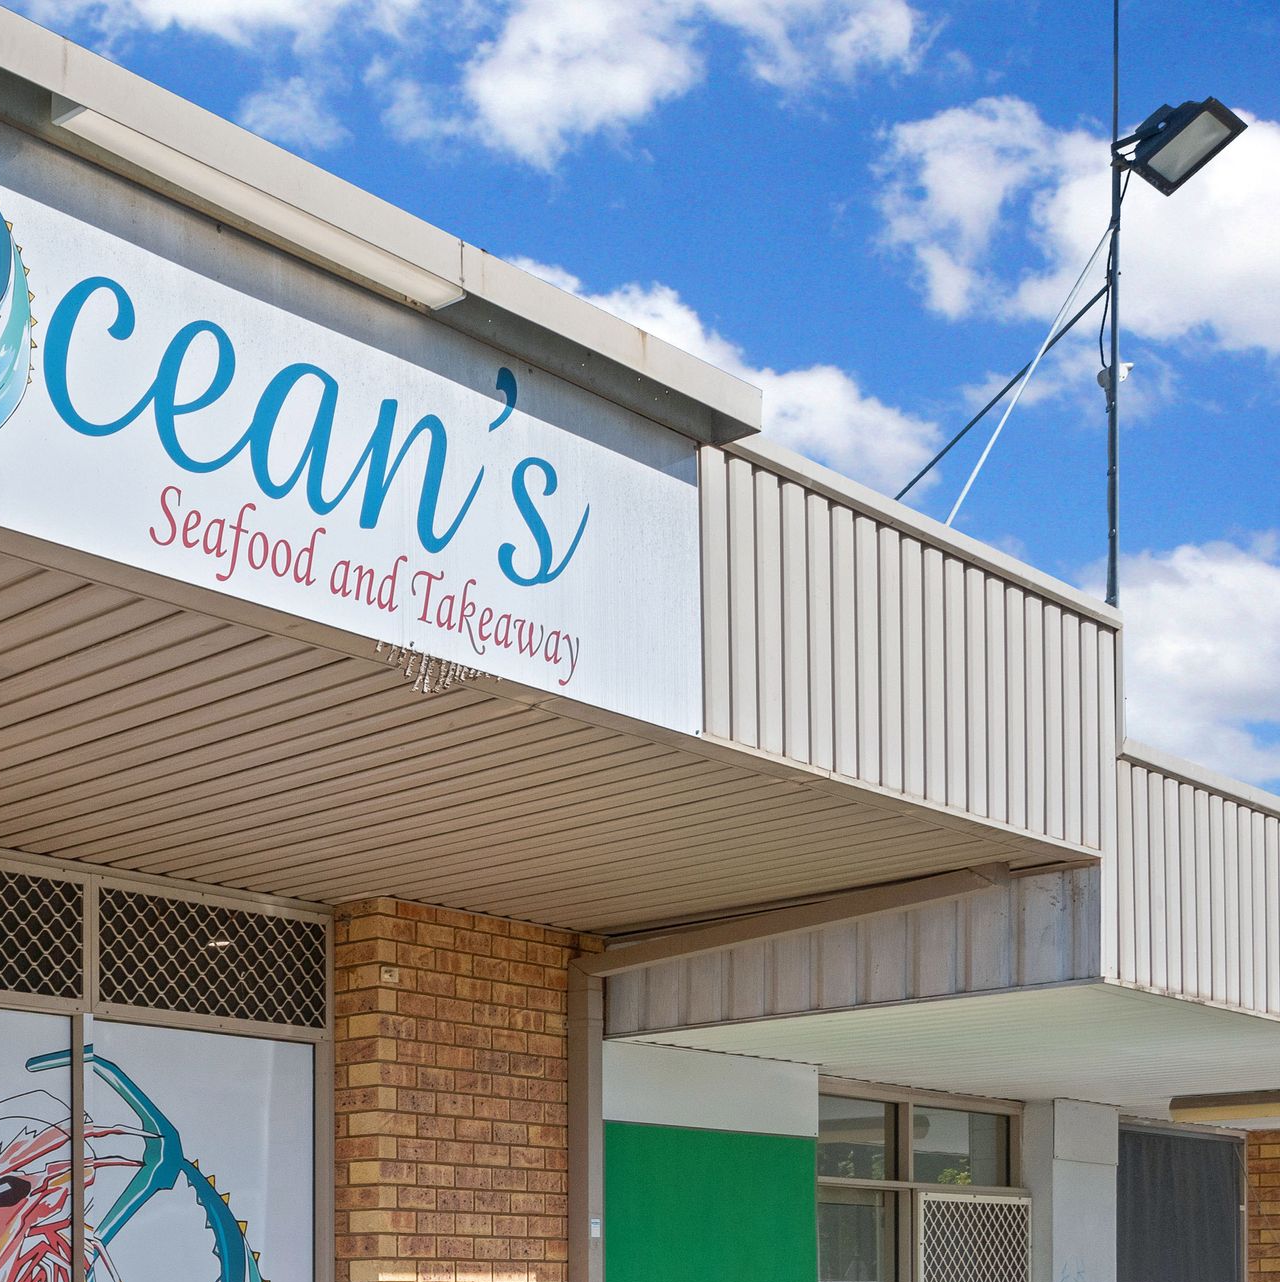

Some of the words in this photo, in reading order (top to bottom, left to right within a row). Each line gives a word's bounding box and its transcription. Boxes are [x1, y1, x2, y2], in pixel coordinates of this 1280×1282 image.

[148, 485, 327, 587] Seafood
[328, 555, 409, 613] and
[410, 569, 581, 687] Takeaway
